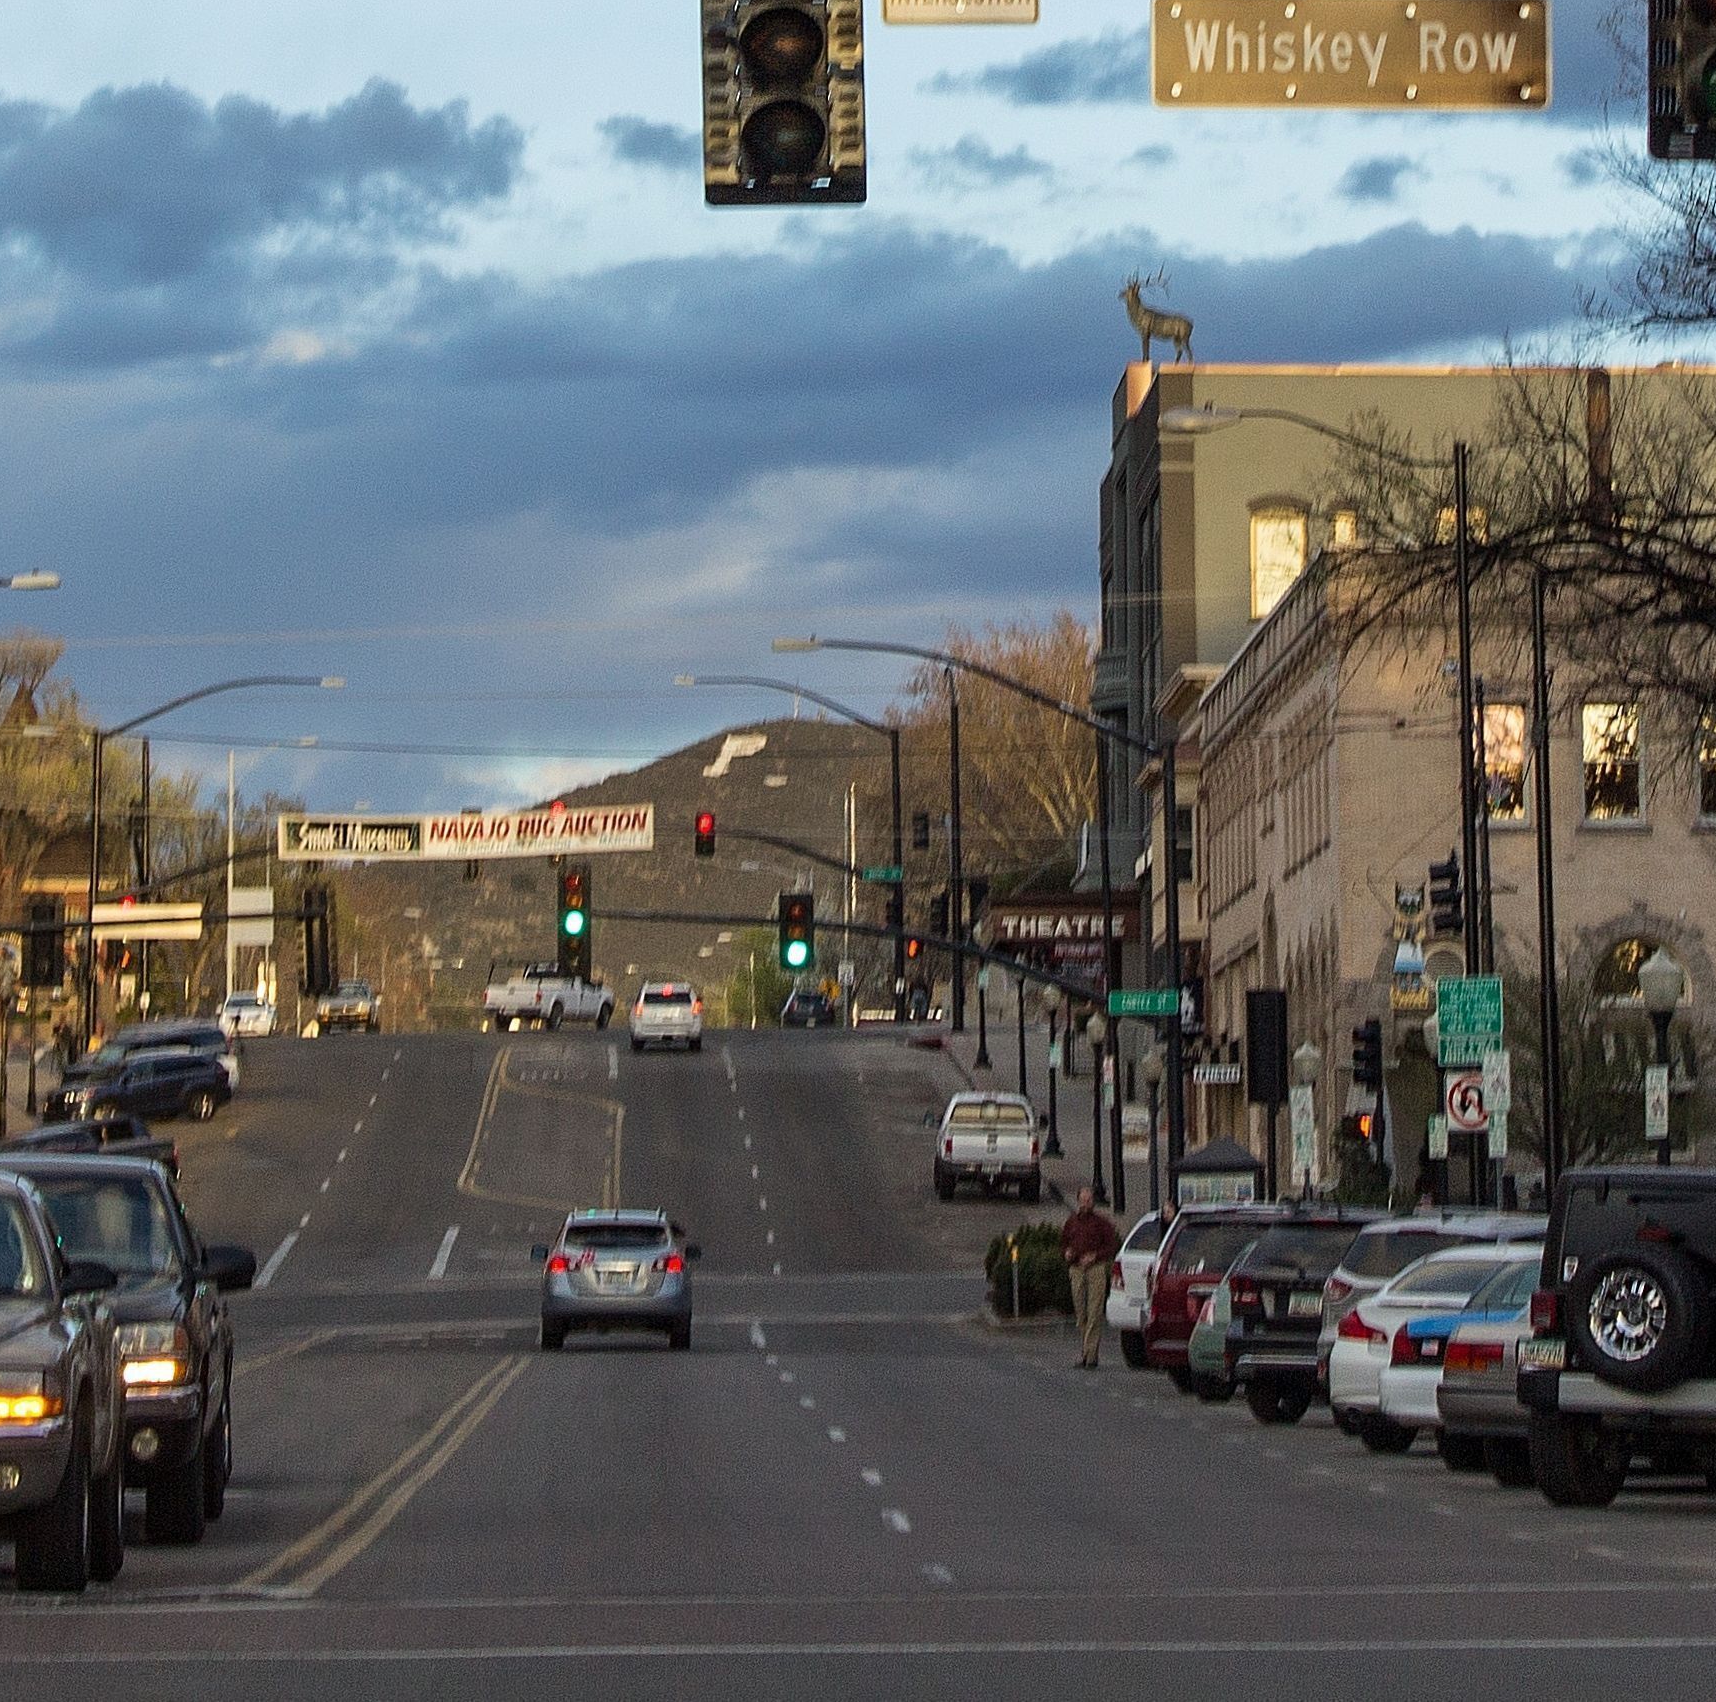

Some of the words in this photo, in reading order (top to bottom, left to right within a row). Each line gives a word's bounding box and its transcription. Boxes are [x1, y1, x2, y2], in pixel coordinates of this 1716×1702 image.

[1183, 17, 1389, 89] Whiskey
[1418, 20, 1518, 76] Row
[347, 819, 416, 853] Museum
[428, 817, 511, 844] NAVAJO
[516, 815, 556, 841] RUG
[560, 809, 649, 839] AUCTION
